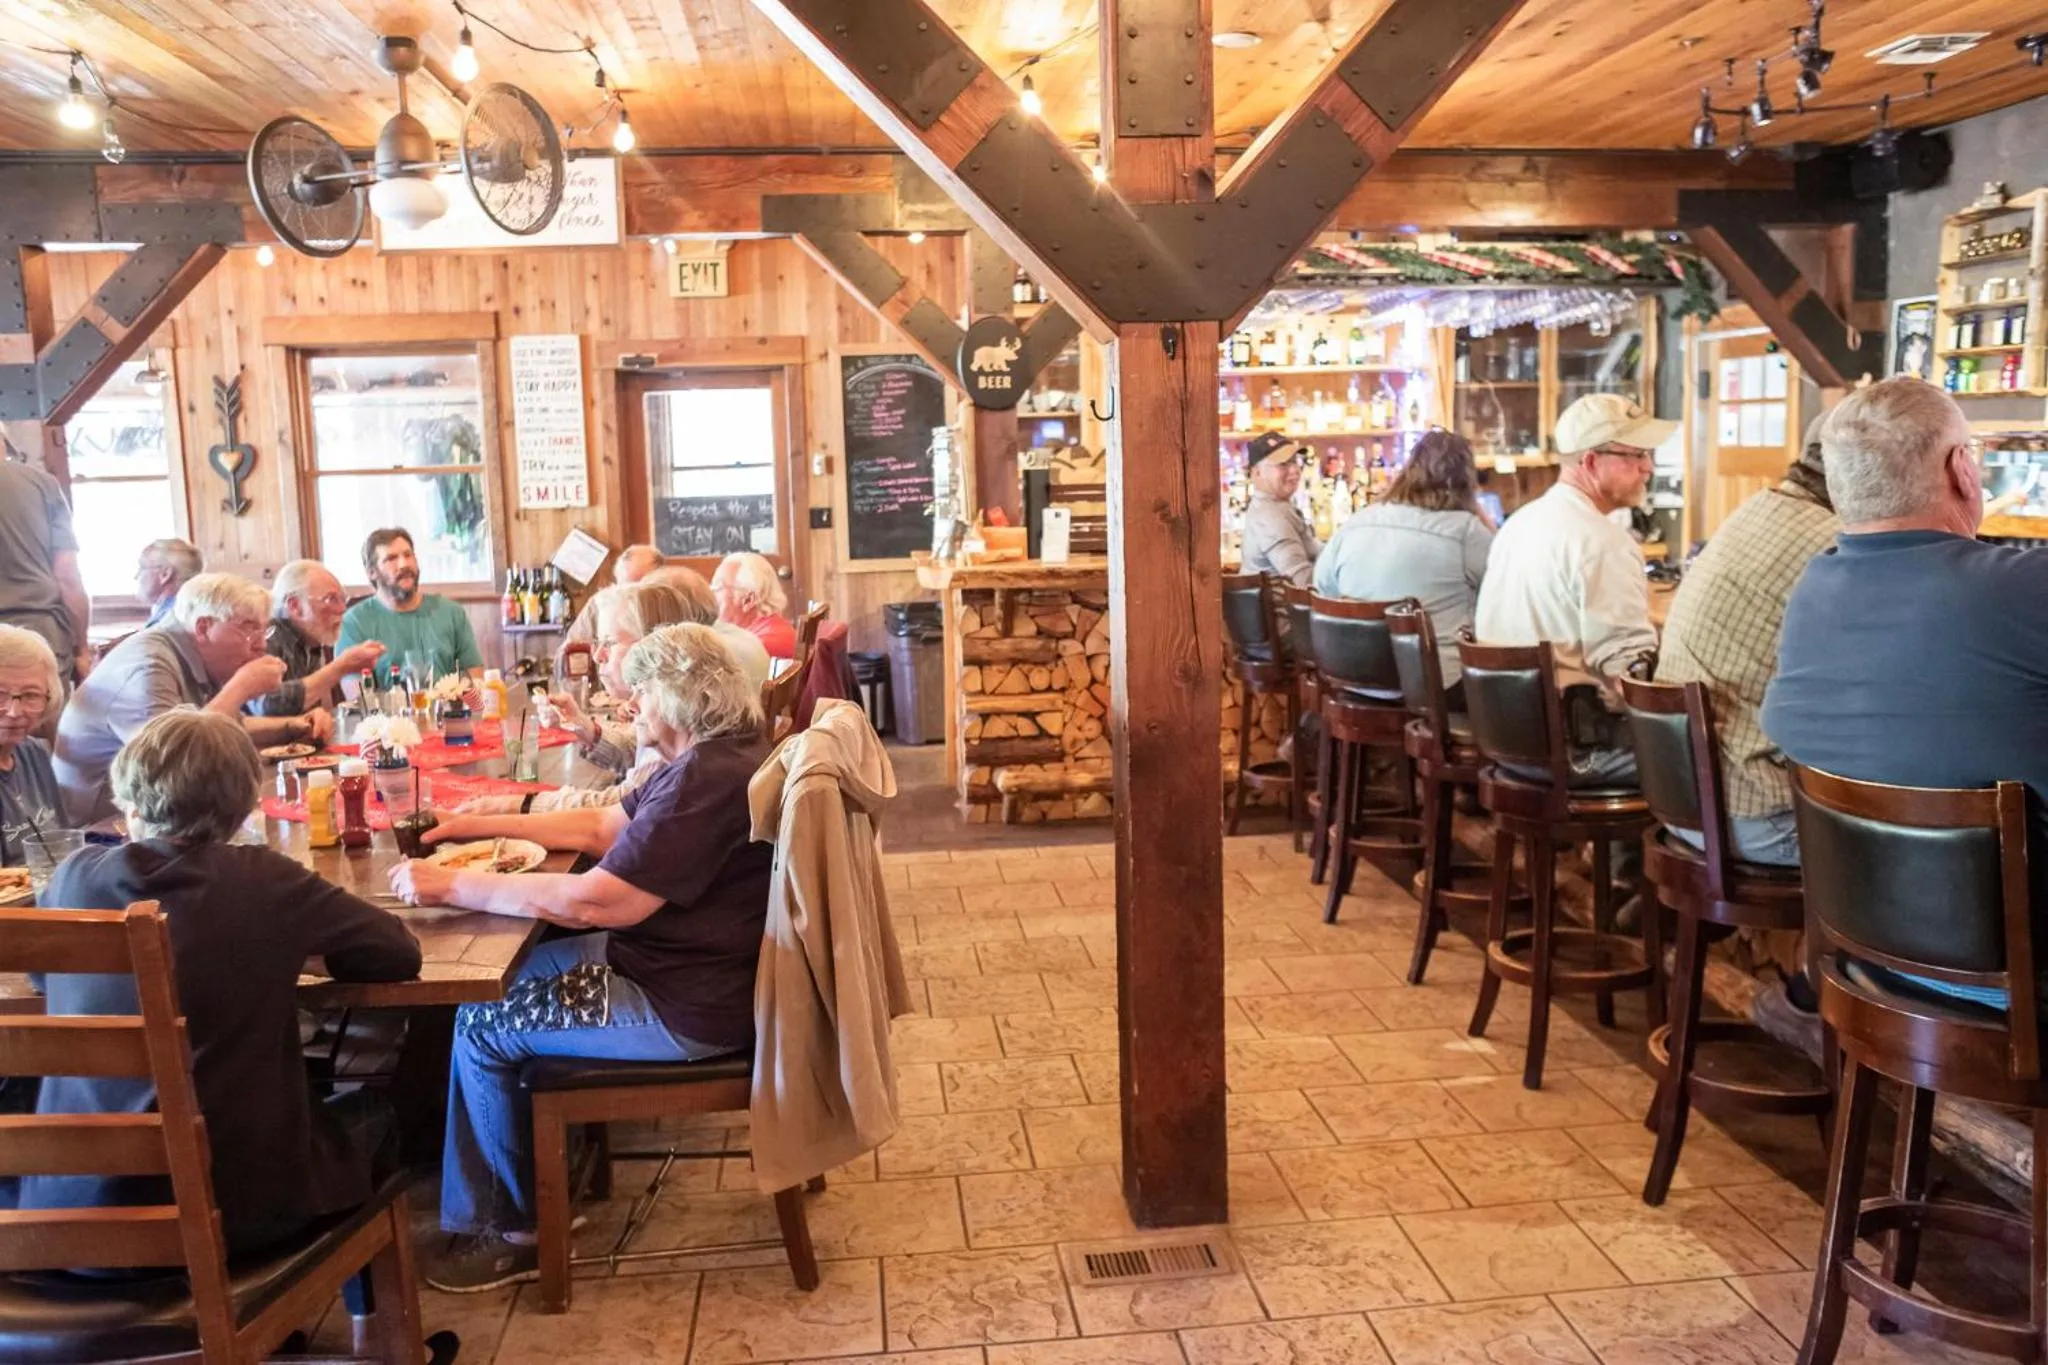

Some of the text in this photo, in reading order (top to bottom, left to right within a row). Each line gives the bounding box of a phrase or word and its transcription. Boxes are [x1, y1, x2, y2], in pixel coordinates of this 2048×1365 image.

[679, 262, 720, 292] EXIT
[978, 376, 1012, 389] BEER
[522, 484, 584, 502] SMILE
[671, 525, 714, 552] STAY
